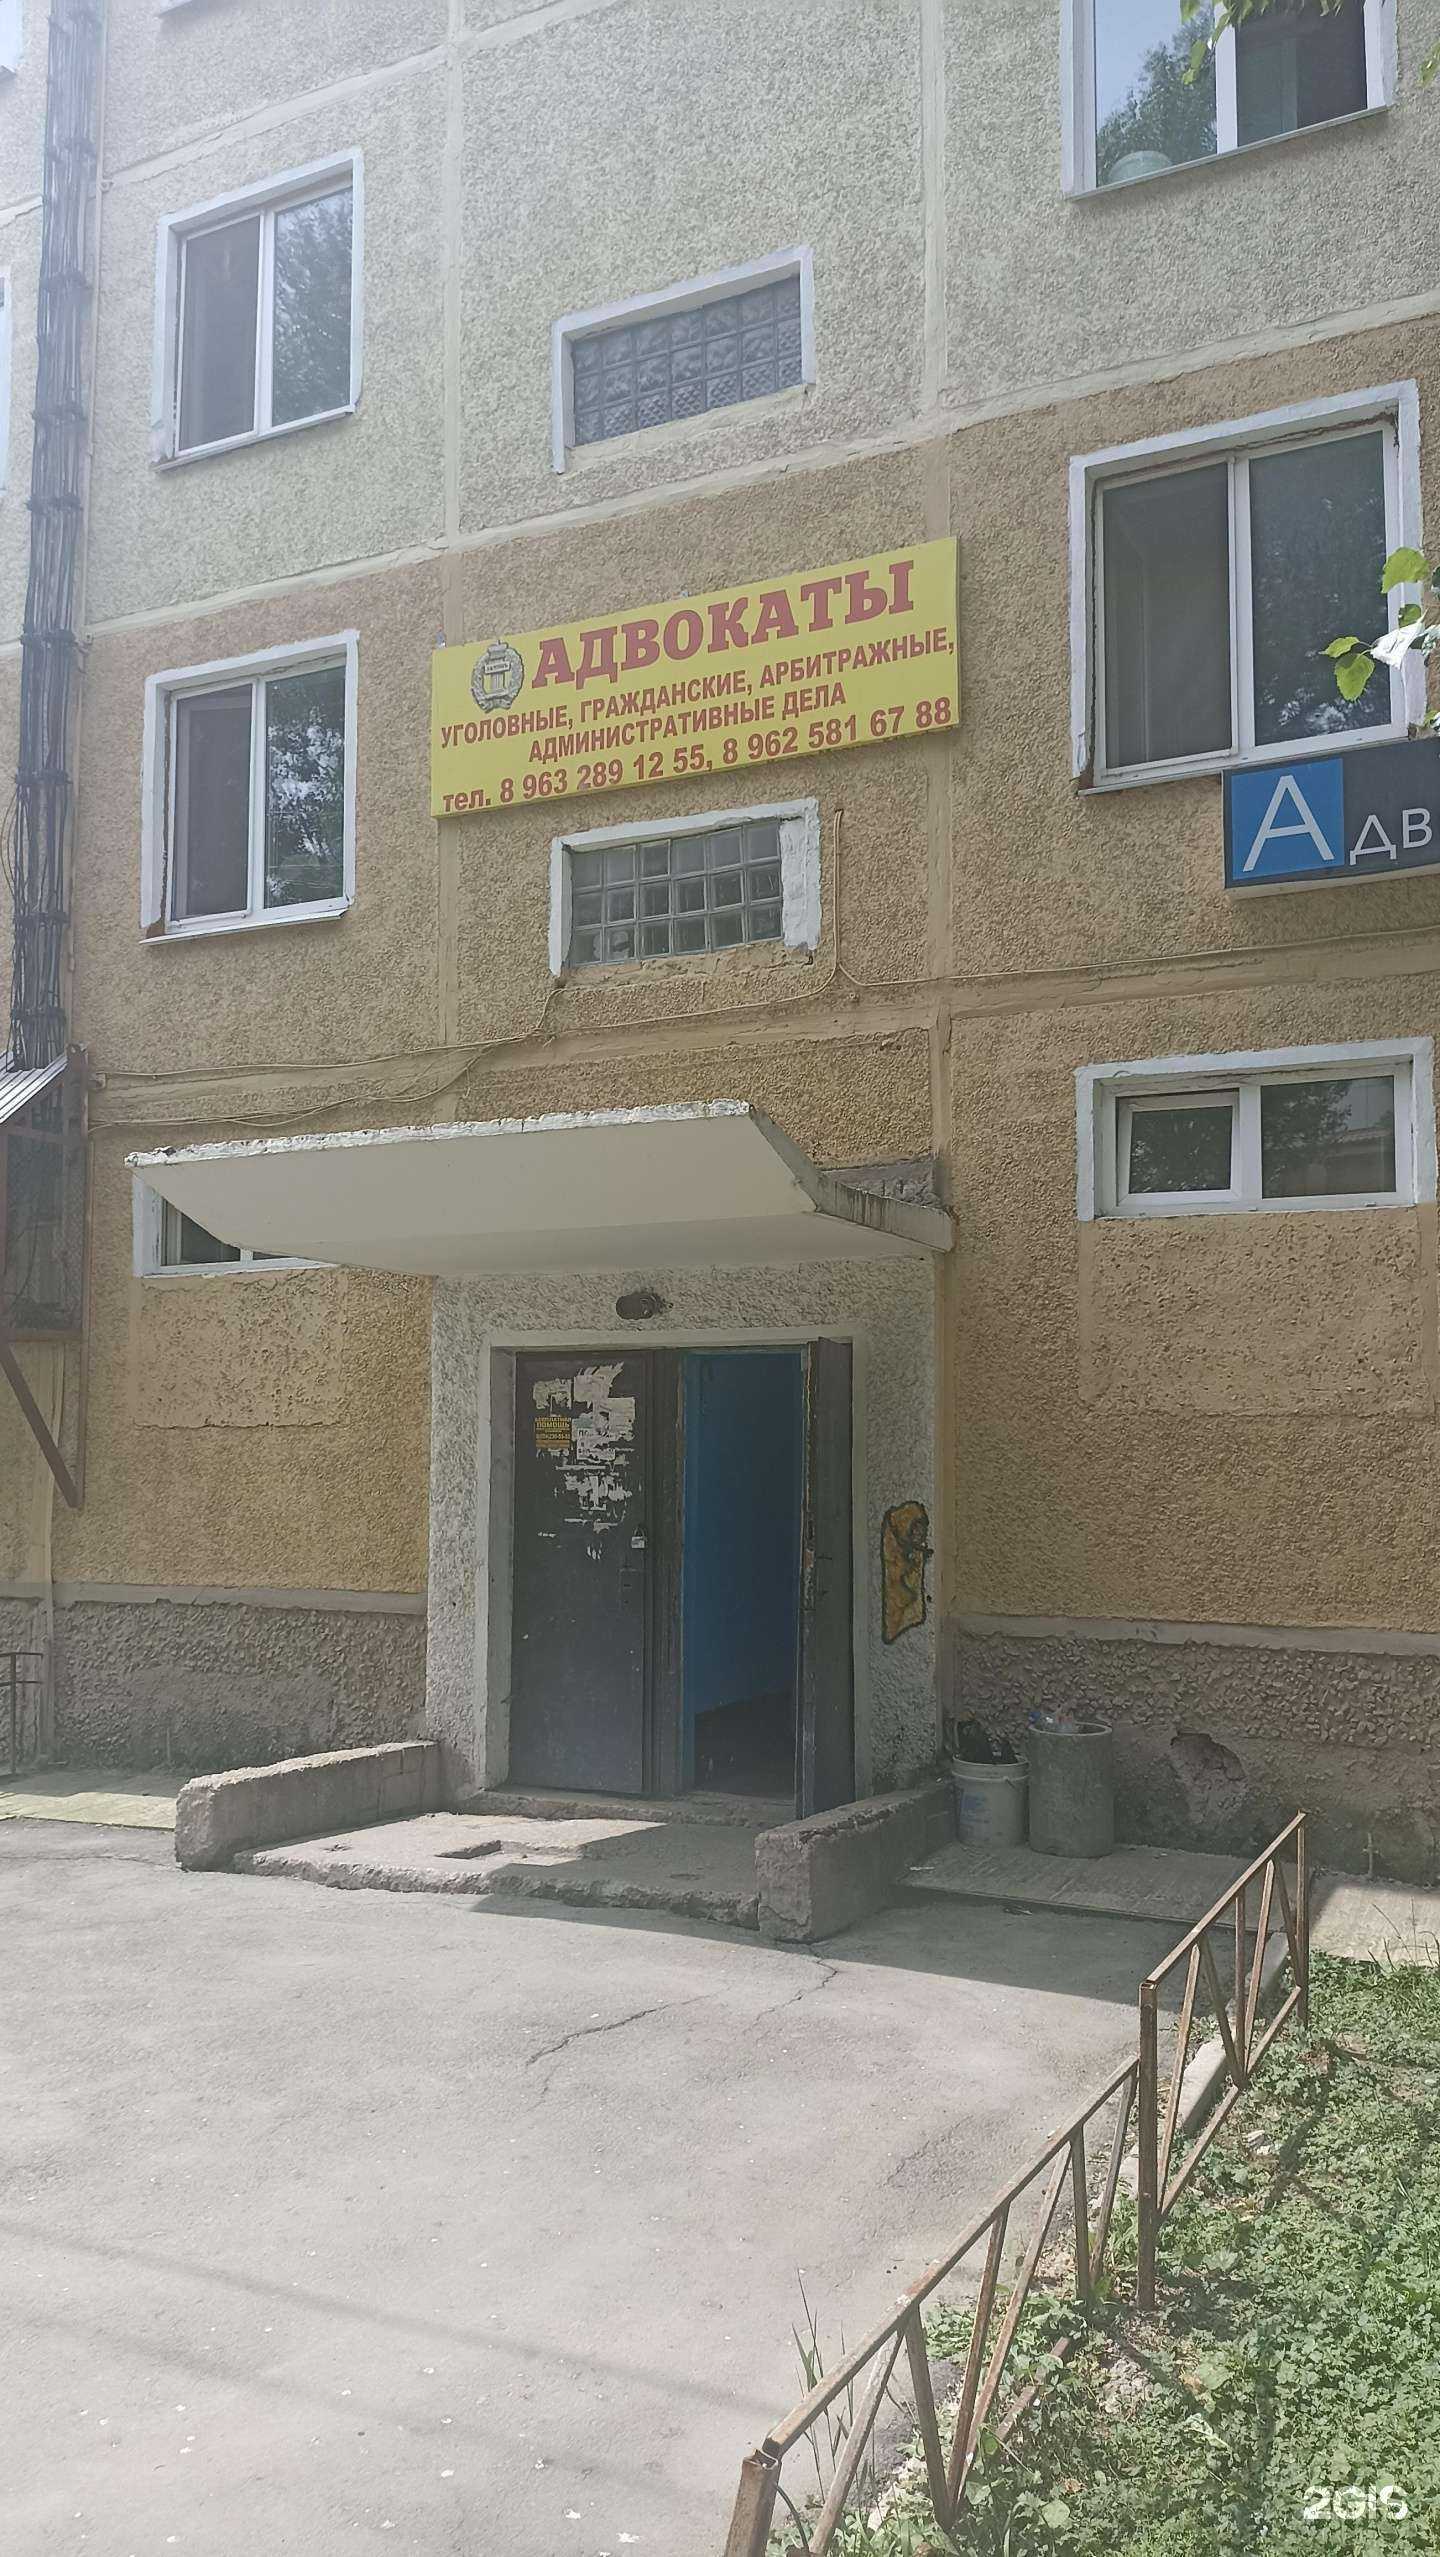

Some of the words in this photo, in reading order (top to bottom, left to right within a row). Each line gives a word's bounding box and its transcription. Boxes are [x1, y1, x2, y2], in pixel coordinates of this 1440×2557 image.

[531, 560, 914, 690] АДВОКАТЫ
[441, 704, 573, 749] УГОЛОВНЫЕ,
[580, 669, 753, 723] ГРАЖДАНСКИЕ,
[759, 627, 955, 689] АРБИТРАЖНЫЕ,
[528, 695, 775, 765] АДМИНИСТРАТИВНЫЕ
[781, 682, 847, 721] ДЕЛА
[443, 788, 492, 813] тел.
[499, 778, 515, 803] 8
[522, 767, 568, 801] 963
[576, 759, 624, 791] 289
[632, 751, 664, 781] 12
[672, 743, 713, 774] 55,
[722, 738, 739, 765] 8
[747, 726, 799, 760] 962
[808, 714, 857, 749] 581
[869, 706, 905, 737] 67
[915, 696, 951, 729] 88
